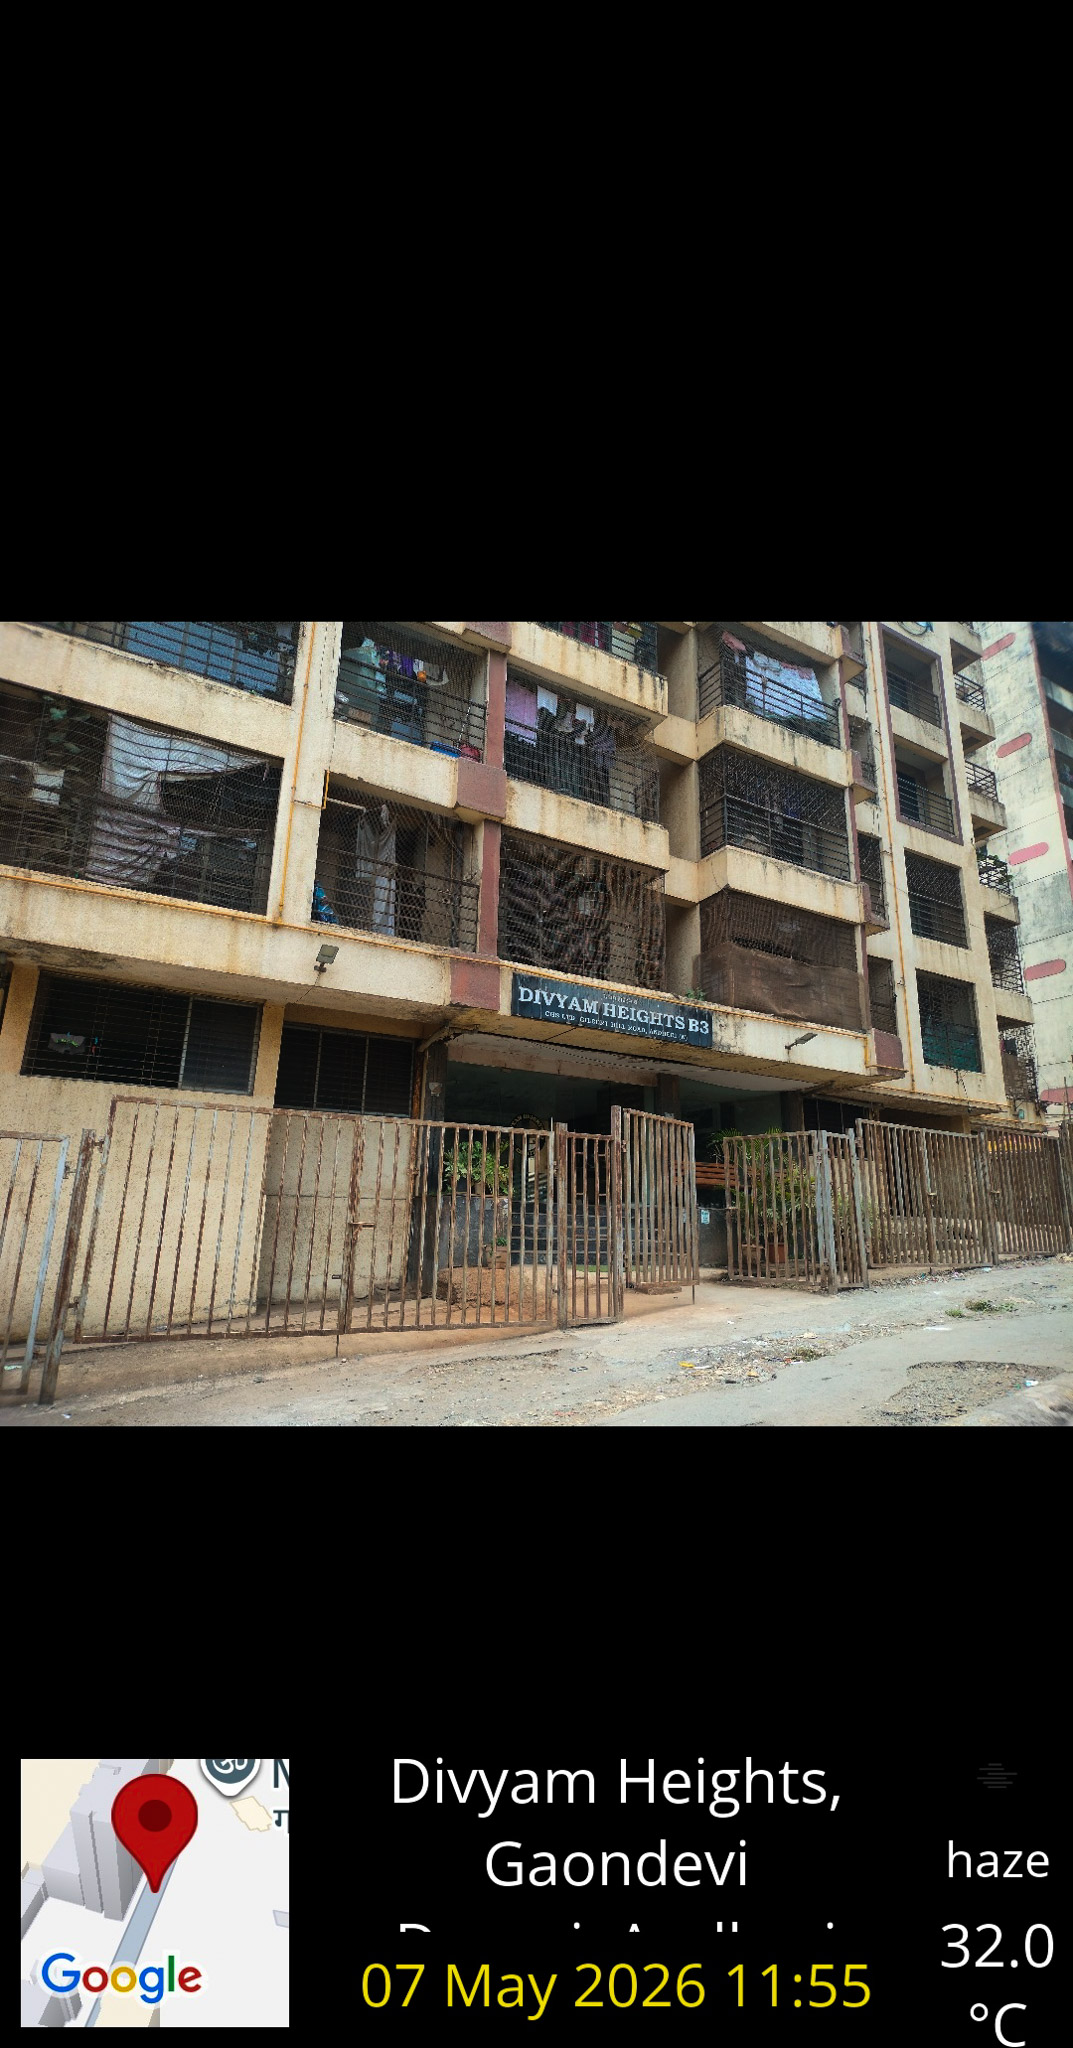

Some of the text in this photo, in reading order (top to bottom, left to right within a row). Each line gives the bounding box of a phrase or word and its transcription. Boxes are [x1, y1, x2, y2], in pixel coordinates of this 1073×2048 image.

[518, 986, 598, 1014] DIVYAM
[602, 1002, 685, 1030] HEIGHTS
[688, 1018, 709, 1035] B3
